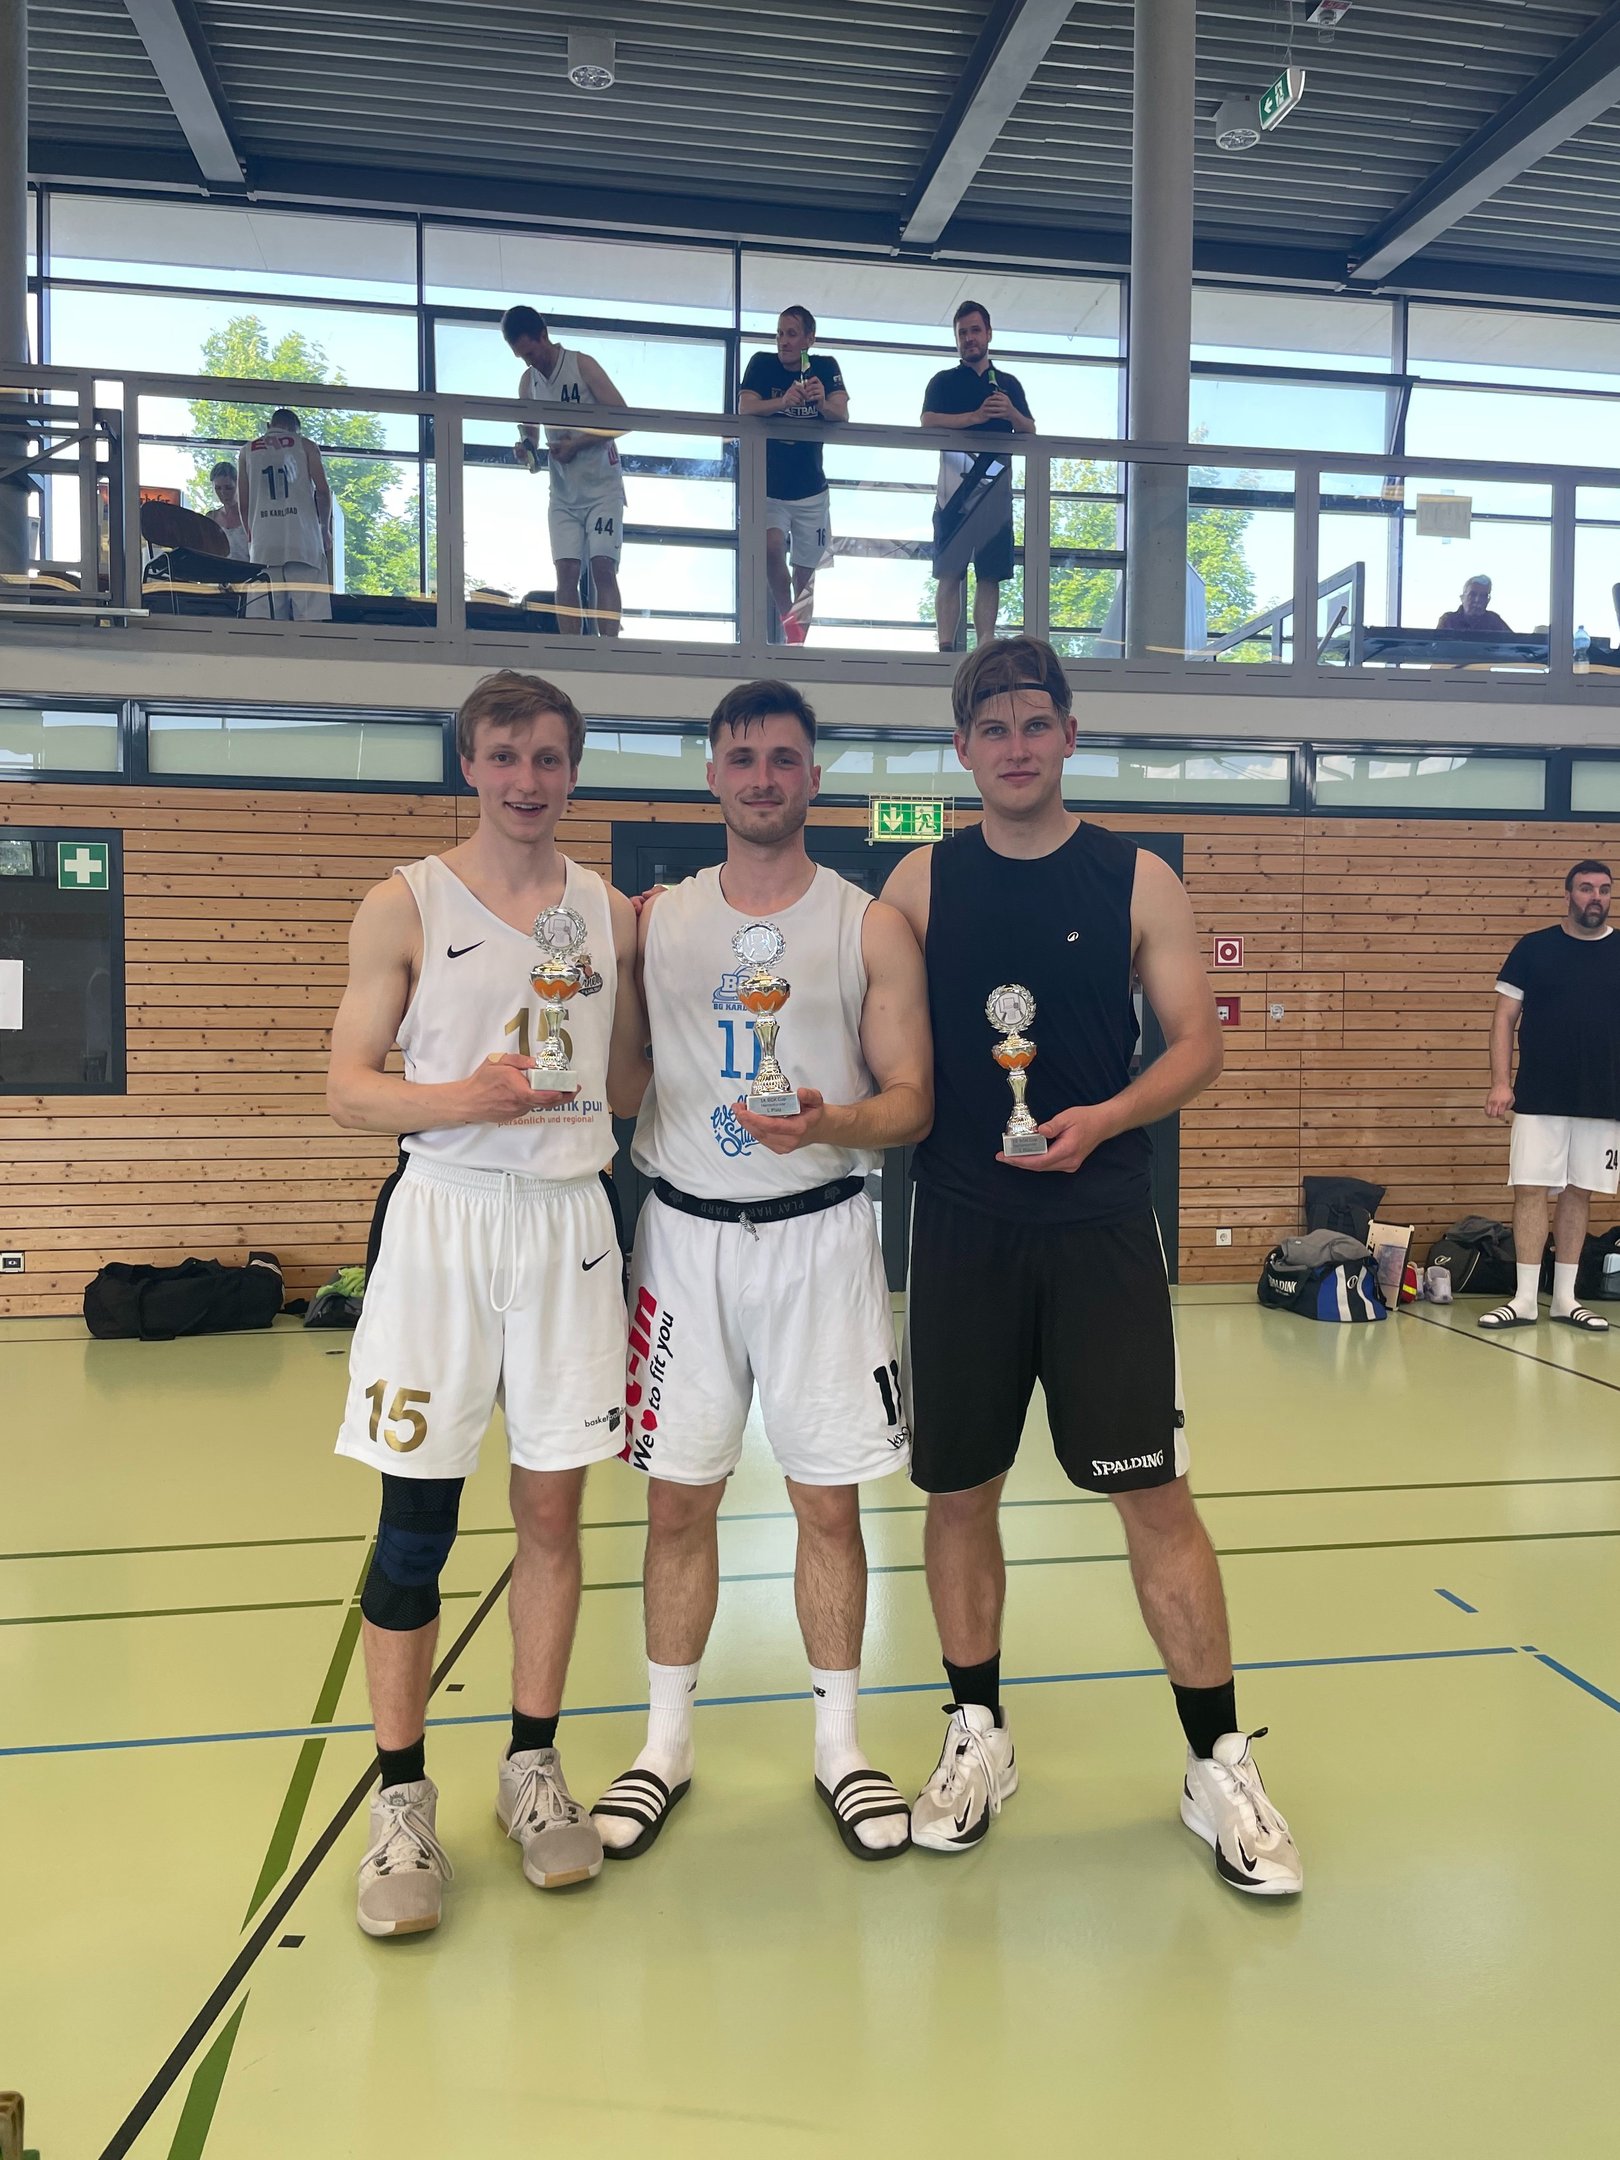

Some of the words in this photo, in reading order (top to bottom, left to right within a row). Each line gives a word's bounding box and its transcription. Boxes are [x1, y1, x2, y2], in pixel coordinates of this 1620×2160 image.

[561, 383, 581, 403] 44
[262, 466, 288, 500] 11
[270, 507, 298, 518] KARLBAD
[594, 517, 614, 536] 44
[725, 1003, 748, 1012] KARL
[563, 1115, 594, 1125] regional
[1605, 1148, 1618, 1170] 24
[657, 1310, 674, 1359] you
[650, 1354, 666, 1384] fit
[649, 1386, 661, 1411] to
[365, 1379, 431, 1453] 15
[633, 1434, 655, 1471] We
[1092, 1449, 1163, 1476] SPALDING
